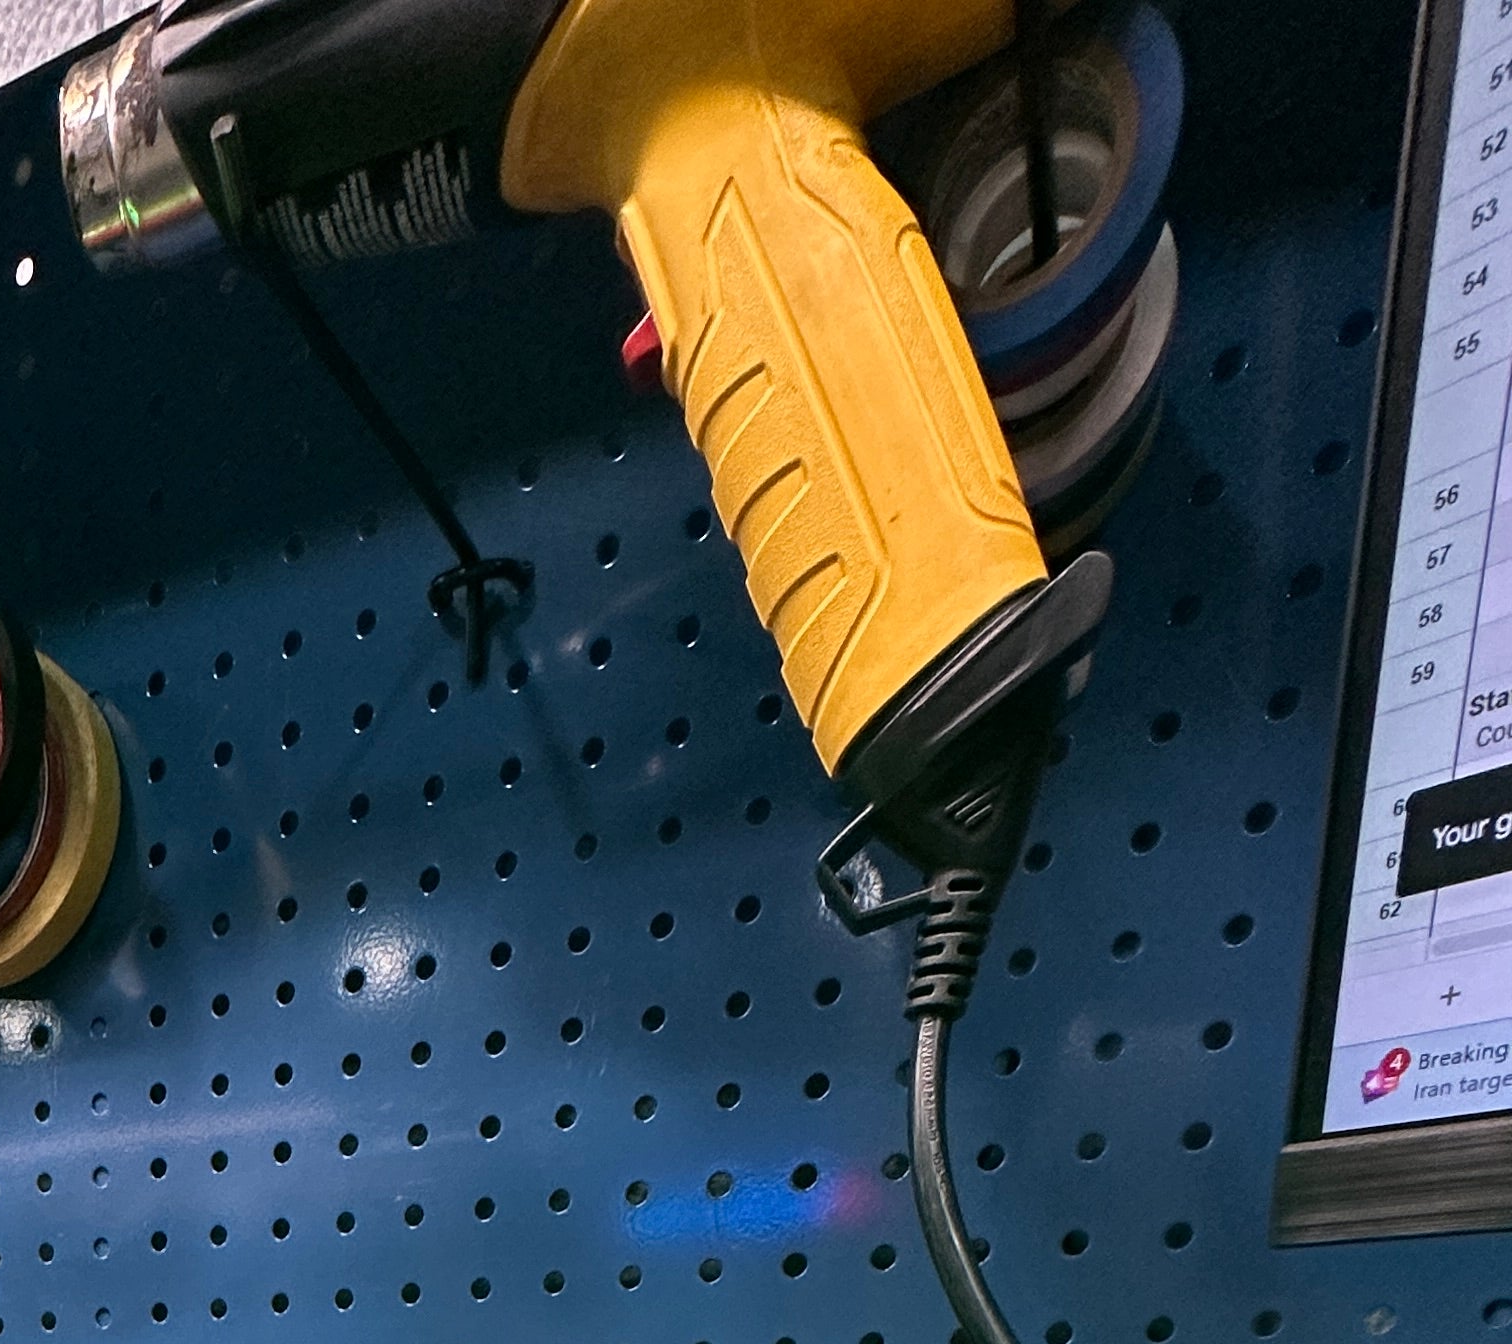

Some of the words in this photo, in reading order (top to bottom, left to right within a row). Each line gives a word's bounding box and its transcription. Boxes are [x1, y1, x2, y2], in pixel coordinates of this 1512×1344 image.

[1480, 127, 1508, 162] 52
[1471, 198, 1498, 231] 53
[1462, 264, 1489, 296] 54
[1453, 330, 1481, 360] 55
[1433, 484, 1460, 511] 56
[1426, 544, 1453, 570] 57
[1418, 603, 1443, 628] 58
[1410, 661, 1435, 685] 59
[1469, 689, 1512, 717] Sta
[1433, 817, 1490, 850] Your
[1379, 900, 1402, 920] 62
[1389, 1053, 1404, 1071] 4
[1418, 1043, 1510, 1071] Breaking
[1414, 1082, 1453, 1101] Iran
